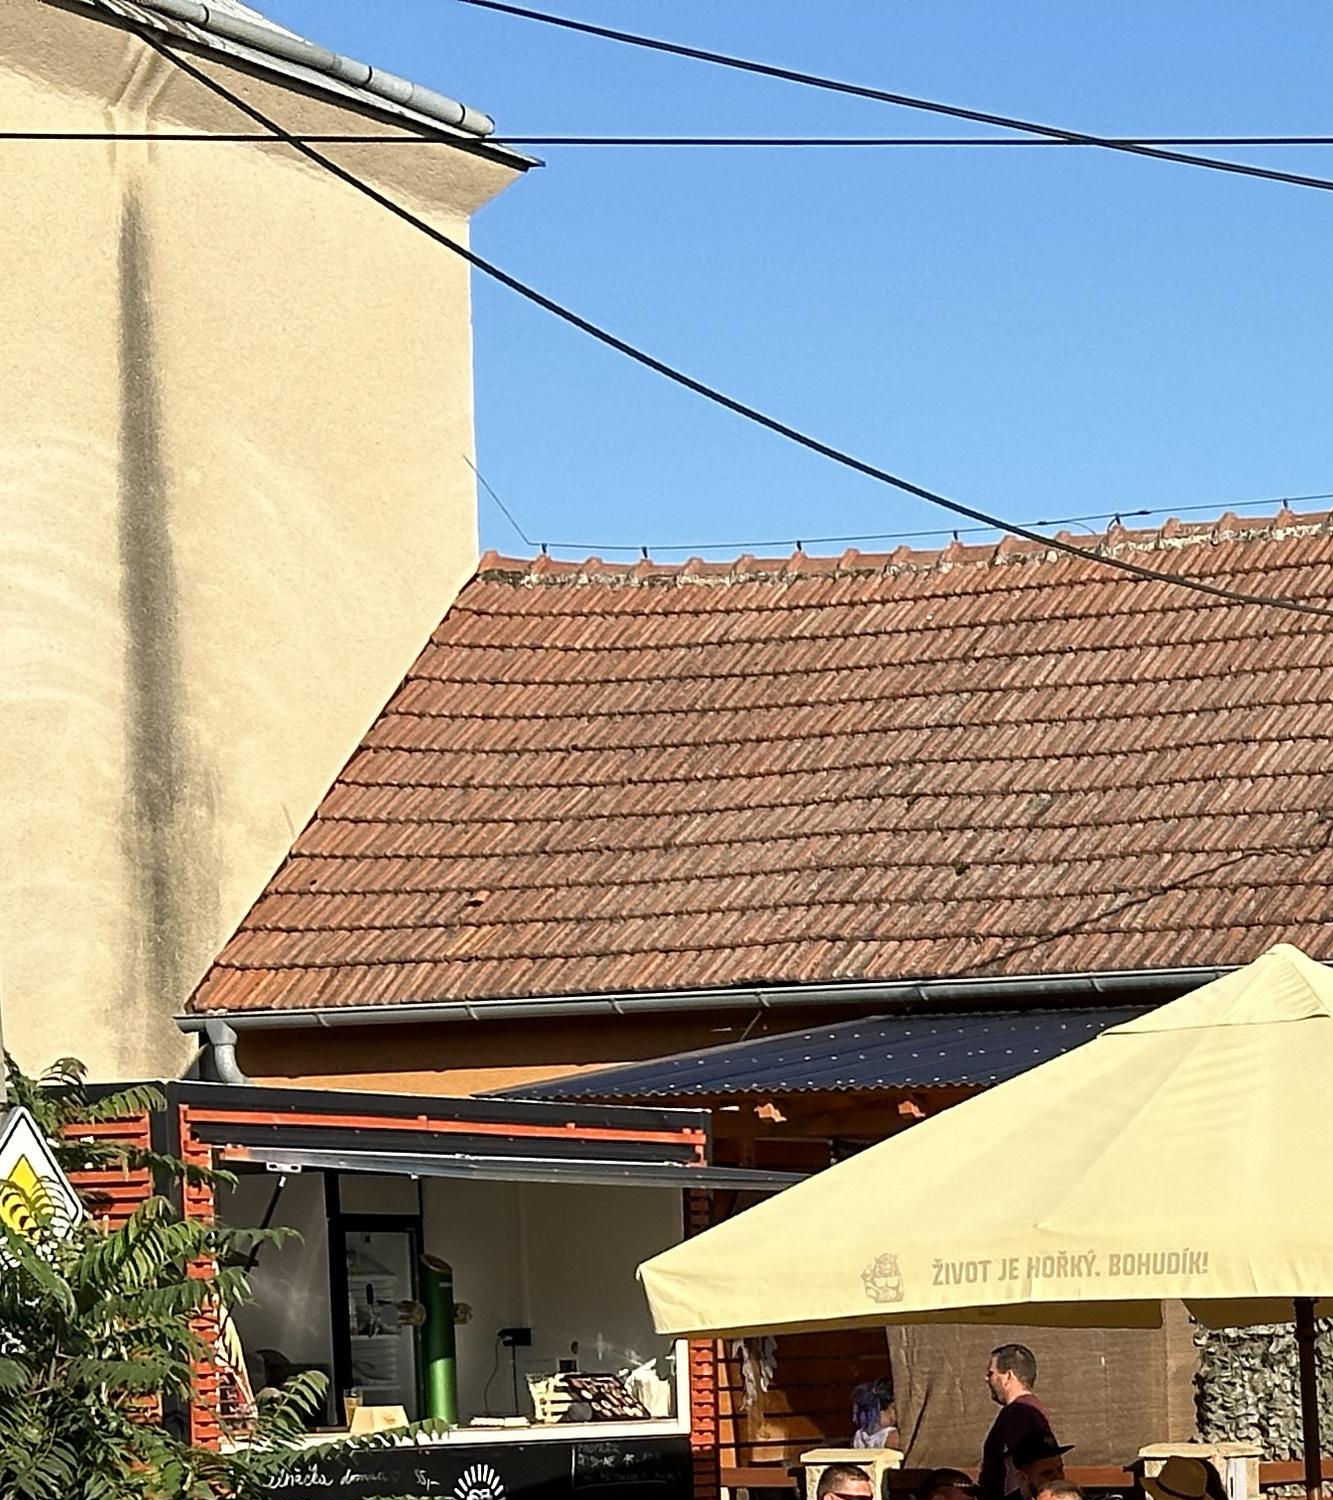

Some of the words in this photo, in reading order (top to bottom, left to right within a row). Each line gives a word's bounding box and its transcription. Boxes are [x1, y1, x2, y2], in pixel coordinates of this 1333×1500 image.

[932, 1258, 992, 1287] ŽIVOT
[998, 1257, 1020, 1281] JE
[1108, 1247, 1209, 1278] BOHUDÍK!
